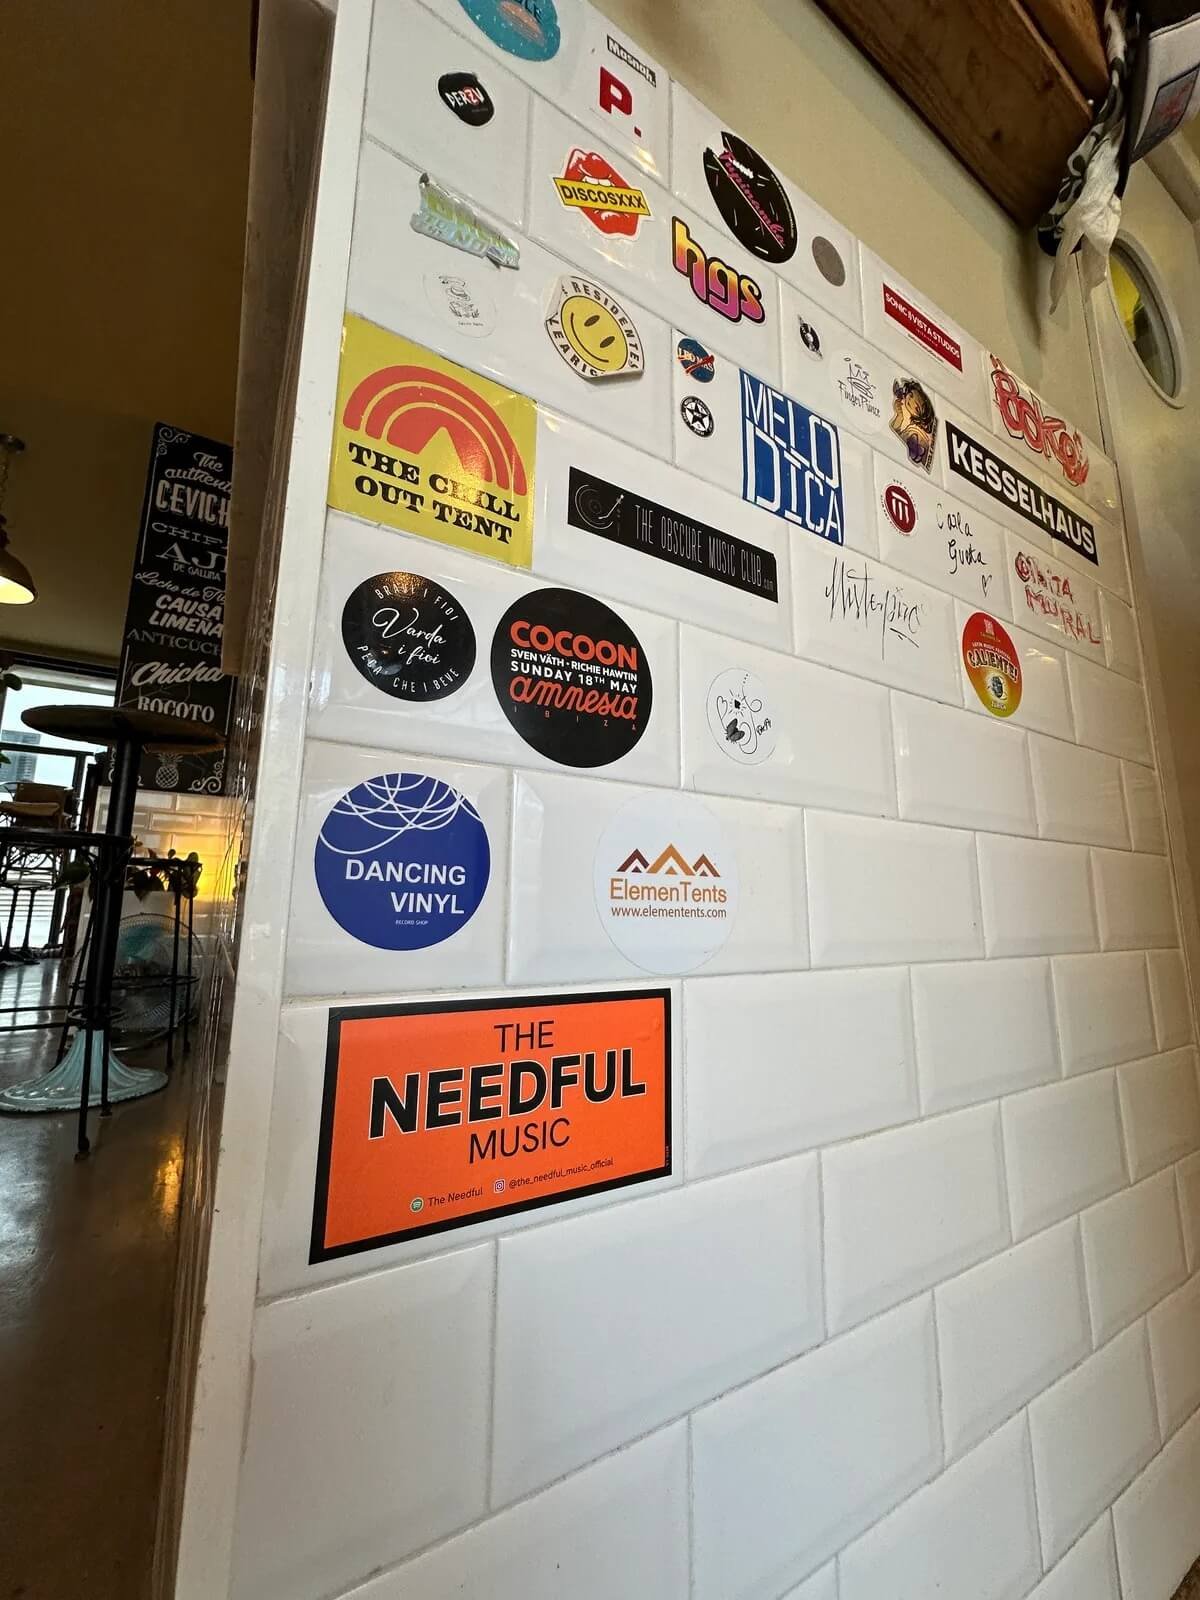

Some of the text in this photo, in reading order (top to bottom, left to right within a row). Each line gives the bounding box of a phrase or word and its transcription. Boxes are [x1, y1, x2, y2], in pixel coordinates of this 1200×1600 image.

[560, 185, 645, 209] DISCOSXXX
[743, 372, 840, 490] MELO
[349, 441, 420, 485] THE
[745, 417, 843, 543] DICA
[951, 432, 1095, 555] KESSELHAUS
[355, 475, 513, 544] OUT TENT
[634, 504, 654, 544] THE
[661, 515, 702, 564] OBSCURE
[708, 535, 736, 577] MUSIC
[155, 594, 223, 621] CAUSA
[434, 596, 459, 621] FIOI
[372, 607, 447, 648] Varda
[398, 644, 441, 665] i fioi
[510, 620, 638, 671] COCOON
[131, 660, 225, 686] Chicha
[393, 677, 416, 693] CHE
[433, 668, 460, 690] BEVE
[510, 649, 638, 682] SVEN VÄTH RICHIE HAWTIN
[510, 660, 572, 682] SUNDAY
[610, 679, 637, 694] MAY
[967, 648, 1018, 683] CALIENTE!
[137, 695, 216, 723] ROCOTO
[510, 675, 638, 720] amnesia
[345, 859, 466, 886] DANCING
[390, 891, 465, 914] VINYL
[610, 878, 727, 903] ElemenTents
[611, 904, 727, 918] www.elementents.com
[493, 1019, 555, 1053] THE
[368, 1047, 647, 1140] NEEDFUL
[469, 1117, 571, 1164] MUSIC
[508, 1157, 614, 1188] @the_needful_music_official
[428, 1186, 483, 1207] The Needful
